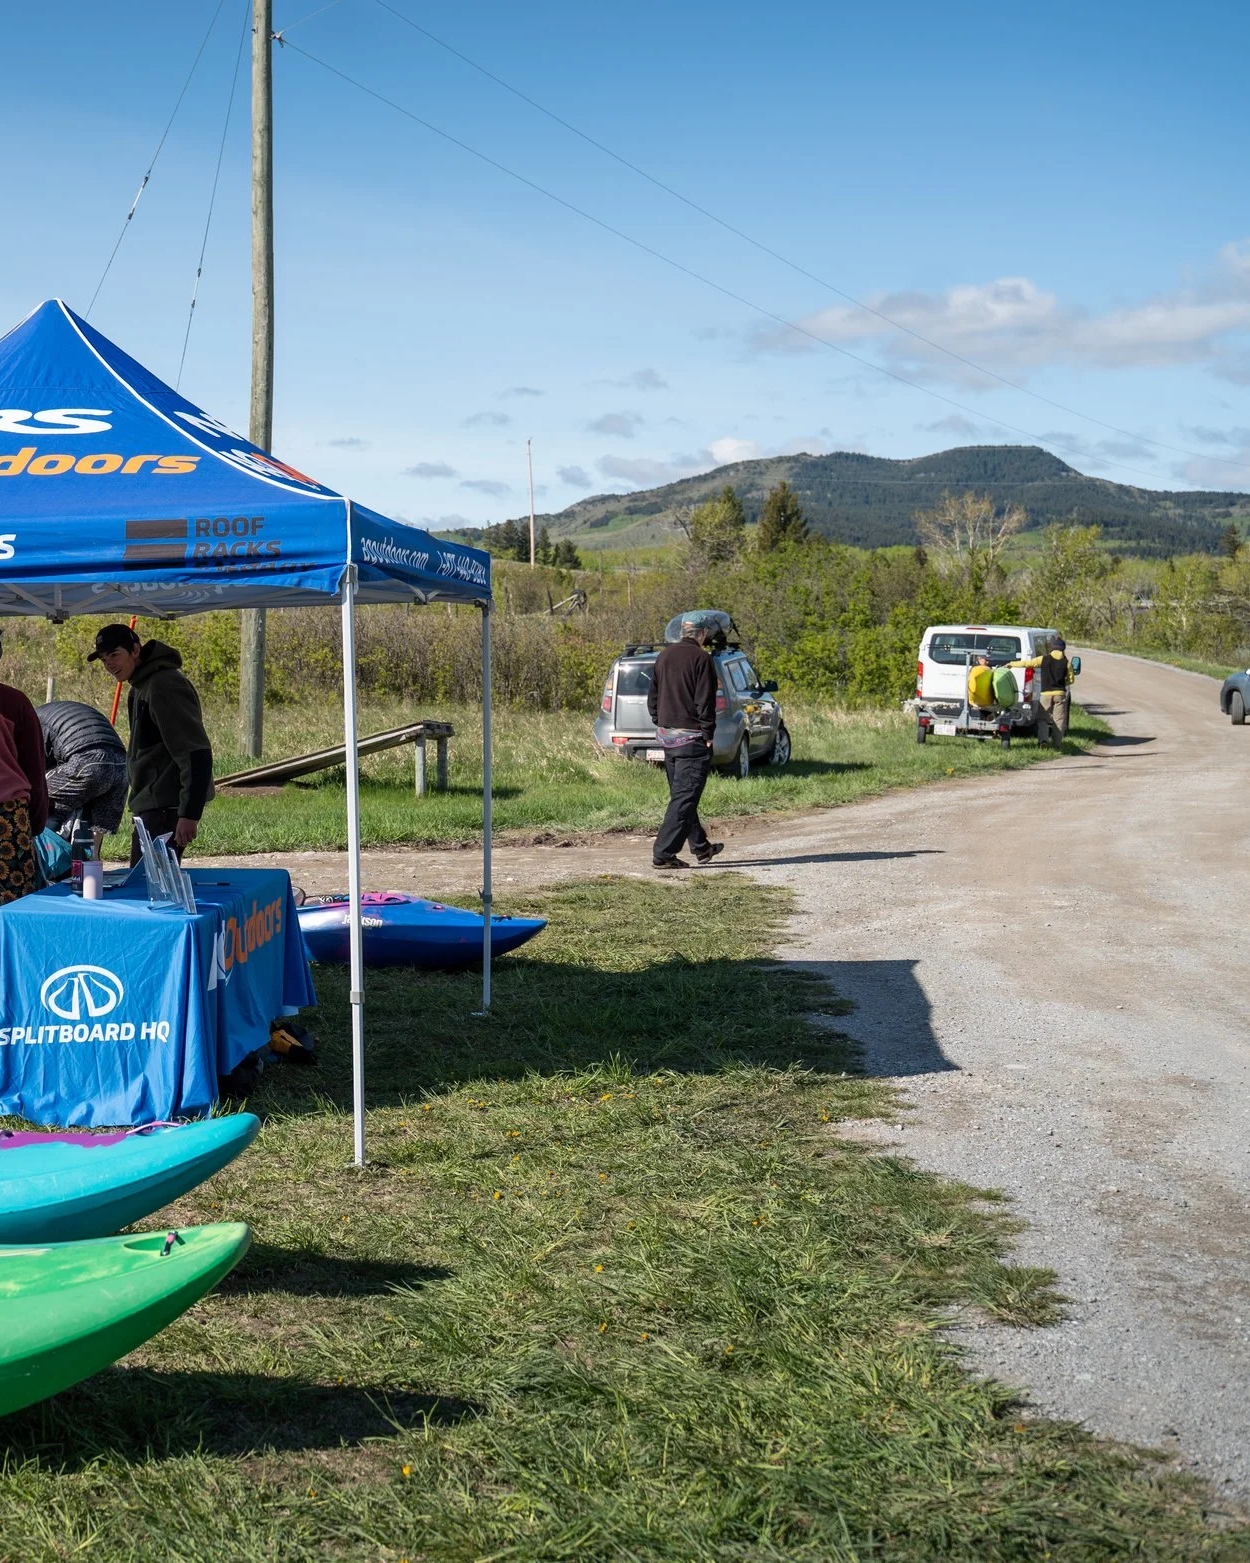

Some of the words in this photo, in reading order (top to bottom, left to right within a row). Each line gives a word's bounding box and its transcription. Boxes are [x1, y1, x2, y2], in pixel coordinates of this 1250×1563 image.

[195, 516, 265, 538] ROOF
[191, 540, 282, 559] RACKS
[342, 913, 383, 928] Jakson
[140, 1021, 170, 1042] HQ
